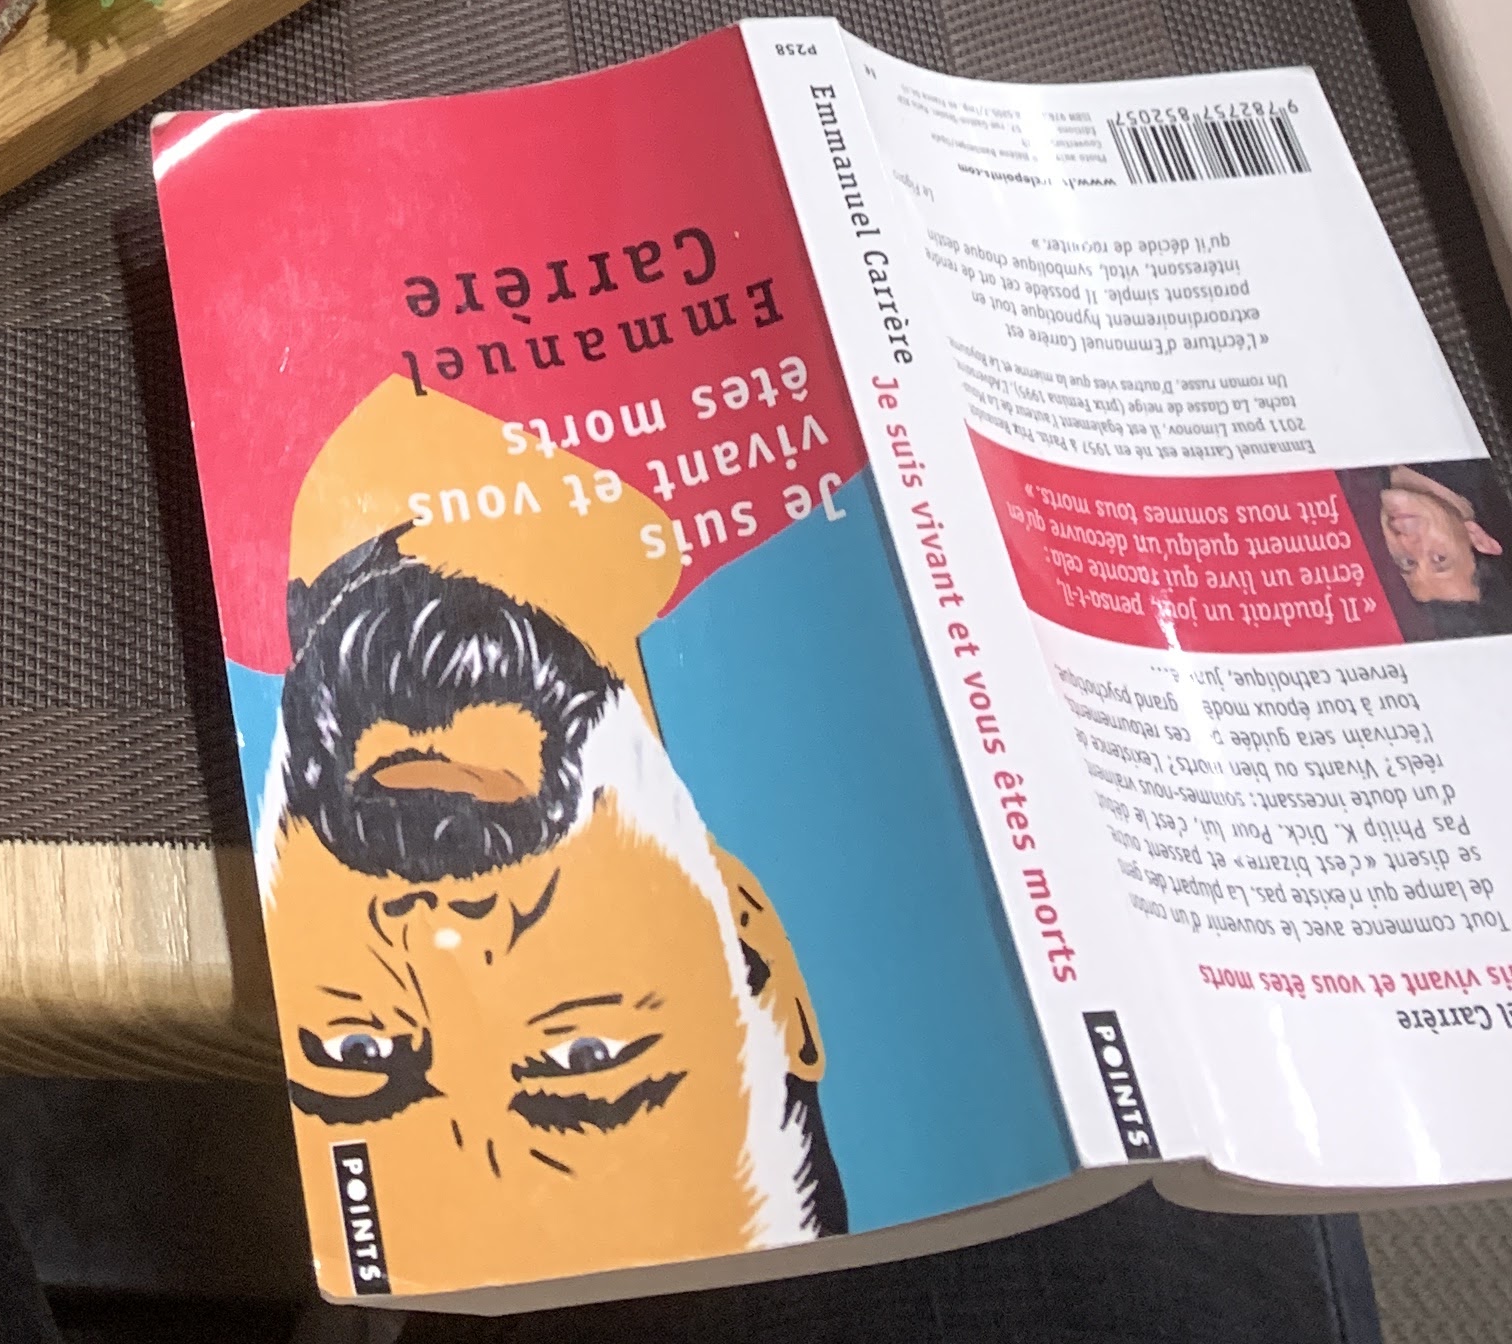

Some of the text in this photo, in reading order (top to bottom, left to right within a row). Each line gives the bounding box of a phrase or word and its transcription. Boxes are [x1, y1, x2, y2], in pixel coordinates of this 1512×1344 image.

[774, 43, 817, 56] P258
[810, 84, 912, 364] Emmanuel Carrère
[926, 229, 1241, 282] intéressant, vital, symbolique chaque destin
[1113, 232, 1231, 257] qu'il décide de
[403, 227, 717, 324] Carrère
[925, 247, 1250, 306] paraissant simple. Il possède cet art de rendre
[971, 292, 1260, 330] extraordinairement hypnotique tout en
[401, 278, 783, 397] Emmanuel
[1005, 323, 1177, 356] d'Emmanuel Carrère est
[1055, 373, 1067, 389] la
[1070, 374, 1091, 389] que
[1093, 378, 1117, 392] vies
[1220, 375, 1264, 390] roman
[1267, 374, 1288, 389] Un
[501, 355, 808, 459] êtes morts
[1128, 399, 1163, 415] neige
[1167, 402, 1184, 417] de
[1187, 400, 1229, 416] Classe
[1232, 399, 1250, 413] La
[1254, 395, 1296, 412] tache,
[1059, 415, 1124, 436] également
[1126, 423, 1147, 436] est
[1150, 424, 1160, 439] il
[1231, 417, 1266, 433] pour
[1269, 417, 1306, 433] 2011
[1082, 440, 1111, 457] 1957
[1114, 444, 1132, 456] en
[1135, 445, 1153, 459] né
[1155, 446, 1177, 460] est
[1180, 445, 1234, 461] Carrère
[1235, 439, 1316, 459] Emmanuel
[407, 413, 828, 528] vivant et vous
[639, 471, 847, 567] Je suis
[1094, 494, 1339, 526] fait nous sommes tous
[1005, 501, 1352, 563] comment quelqu'un découvre qu'en
[1087, 558, 1364, 595] écrire un livre qui raconte
[1055, 577, 1334, 627] faudrait un pensa-t-il,
[871, 375, 1076, 984] Je suis vivant et vous êtes morts
[1228, 663, 1408, 692] fervent catholique,
[1134, 692, 1420, 721] tour à tour époux grand
[1164, 726, 1191, 743] ces
[1229, 726, 1290, 752] guidée
[1296, 730, 1336, 747] sera
[1342, 722, 1434, 749] l'écrivain
[1073, 727, 1379, 783] Vivants ou bien L'existence de
[1084, 759, 1455, 809] d'un doute sommes-nous vraiment
[1134, 806, 1150, 831] le
[1151, 811, 1188, 838] c'est
[1194, 817, 1226, 843] lui,
[1364, 817, 1427, 843] Philip
[1432, 815, 1471, 836] Pas
[1231, 823, 1273, 845] Pour
[1278, 823, 1329, 846] Dick.
[1334, 823, 1358, 843] K.
[1144, 839, 1481, 872] se disent et passent
[1144, 869, 1493, 910] de lampe qui n'existe pas. La plupart des
[1170, 908, 1510, 943] Tout commence avec le souvenir d'un
[1198, 964, 1481, 1000] vivant et vous êtes morts
[1396, 1004, 1493, 1035] Carrère
[1094, 1026, 1149, 1147] POINTS
[342, 1158, 381, 1281] POINTS
